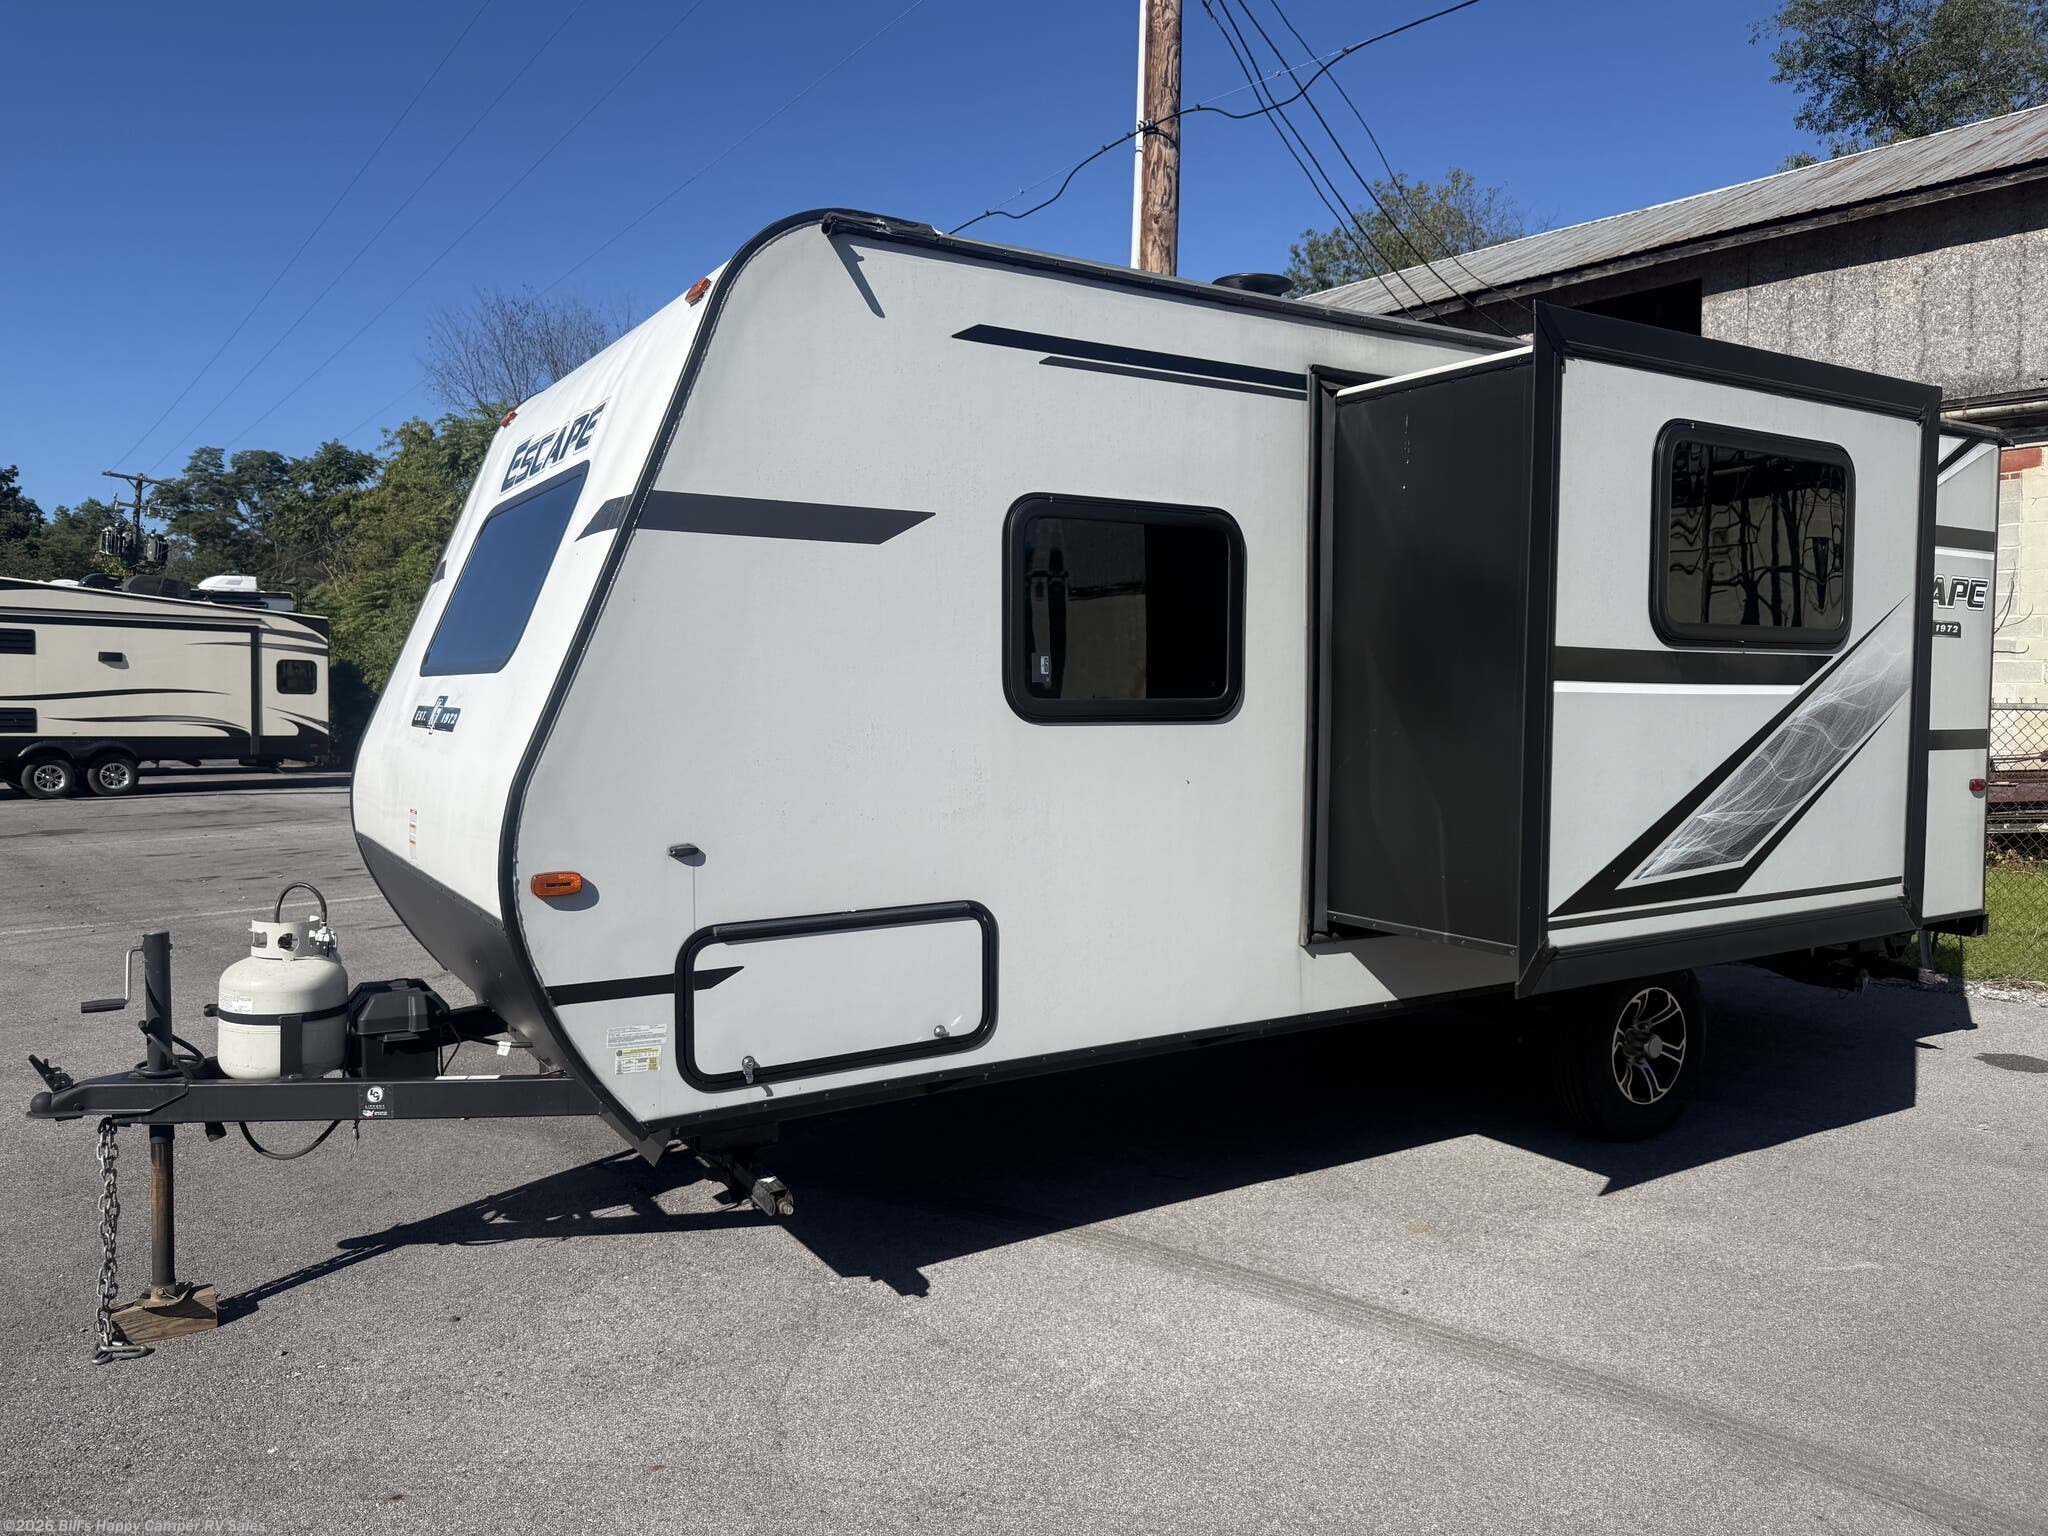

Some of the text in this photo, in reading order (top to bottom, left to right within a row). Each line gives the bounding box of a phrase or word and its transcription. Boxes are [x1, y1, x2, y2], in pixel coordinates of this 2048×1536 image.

[500, 401, 607, 493] ESCAPE
[1935, 624, 1959, 633] 1972
[414, 710, 458, 724] EST. 1972
